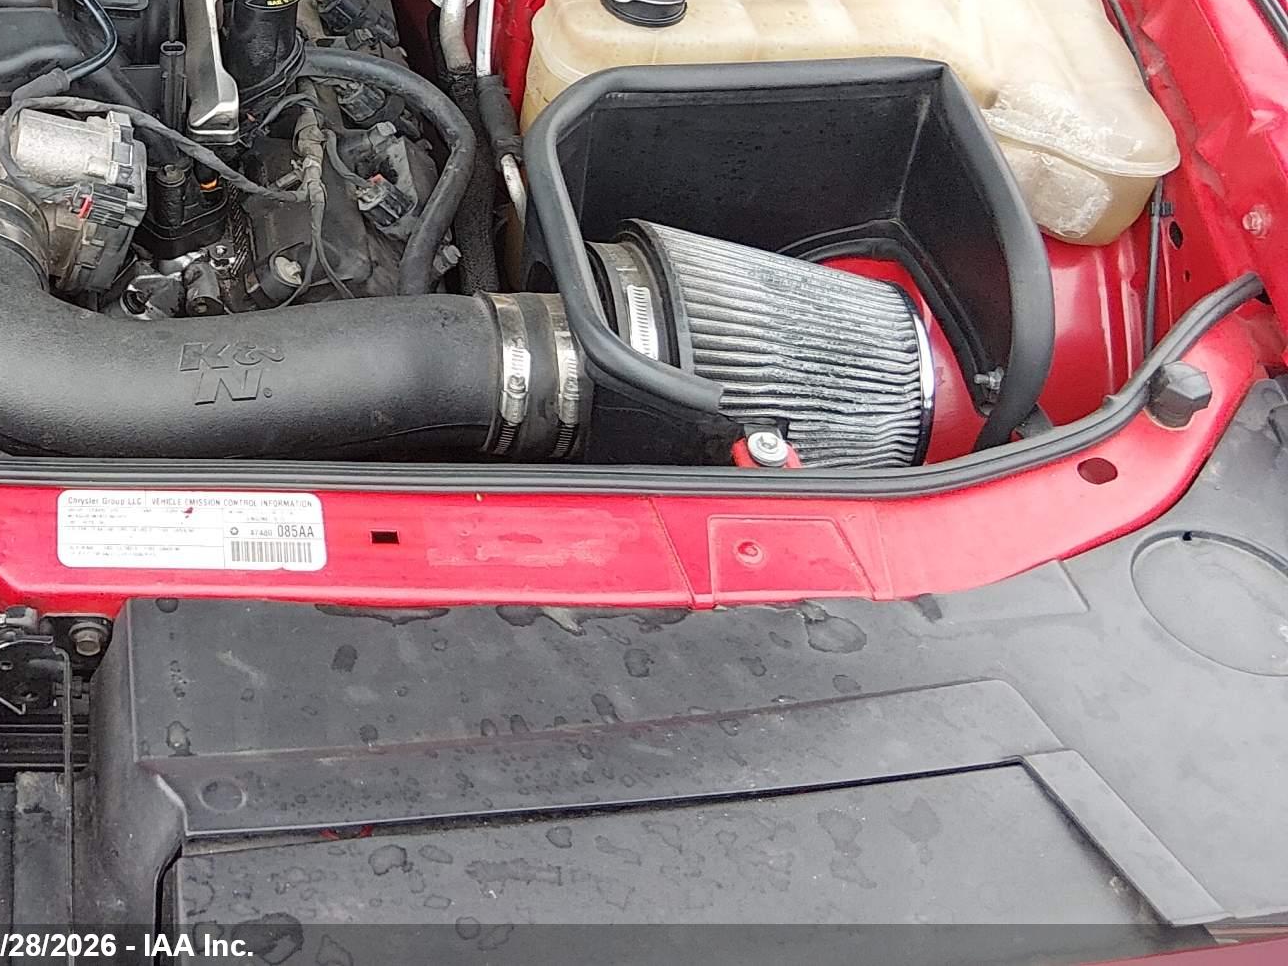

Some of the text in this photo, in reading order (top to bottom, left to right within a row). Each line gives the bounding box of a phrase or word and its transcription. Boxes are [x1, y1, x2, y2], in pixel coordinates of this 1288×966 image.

[68, 497, 142, 507] Chrysler Group LLC
[151, 498, 313, 507] VEHICLE EMISSION CONTROL INFORMATION
